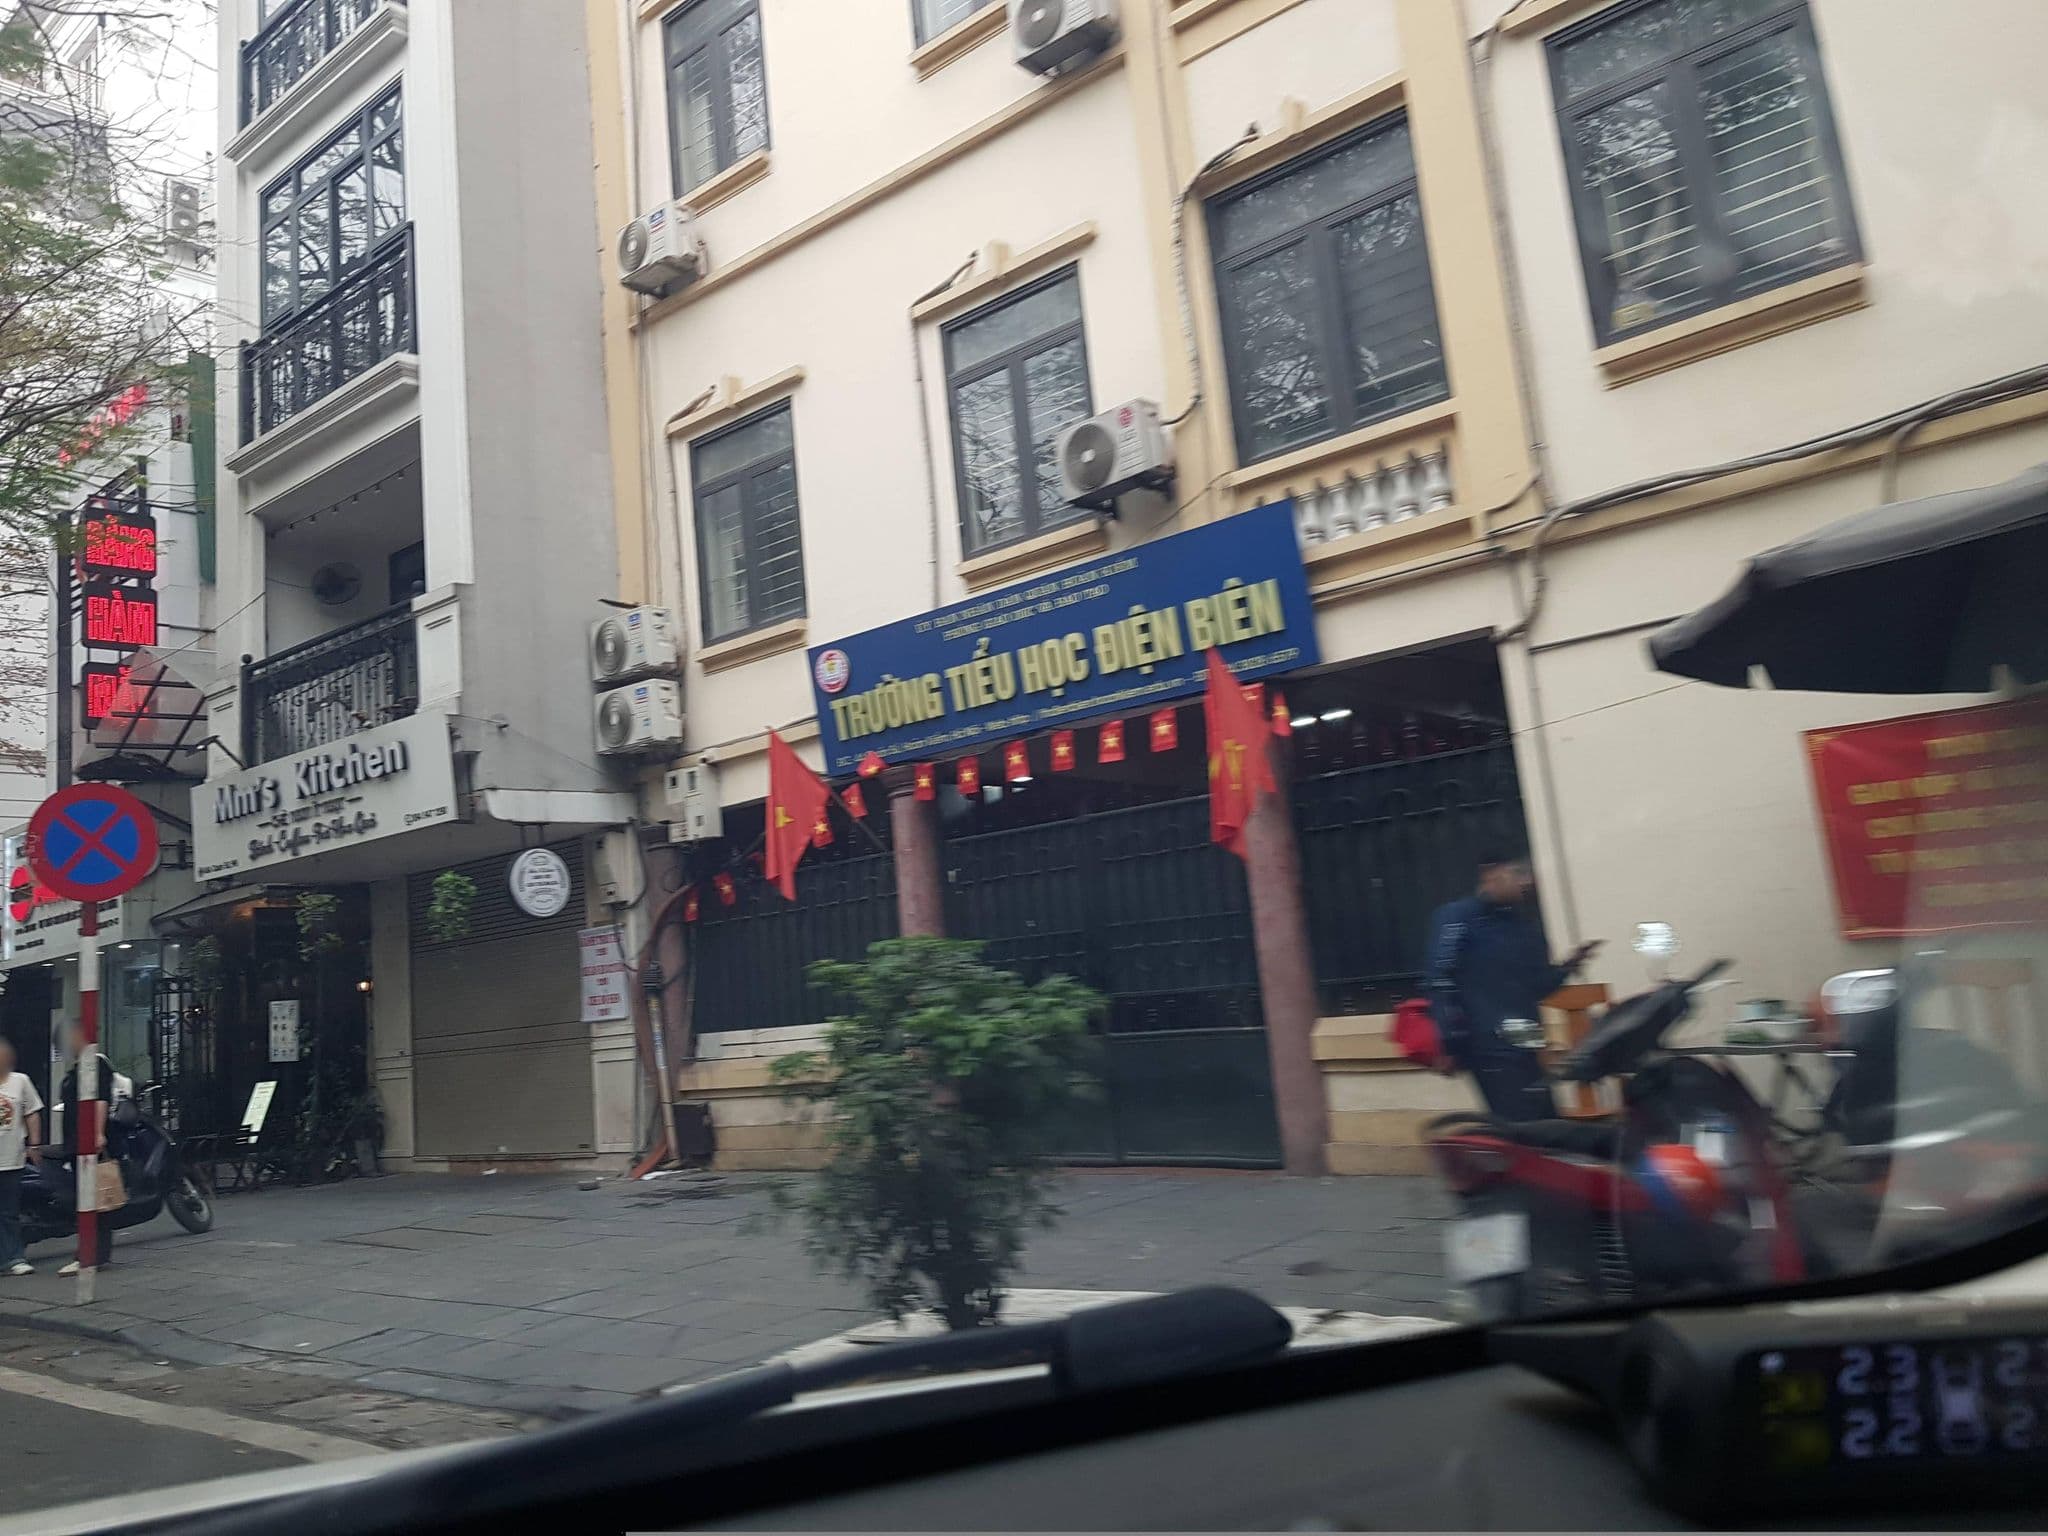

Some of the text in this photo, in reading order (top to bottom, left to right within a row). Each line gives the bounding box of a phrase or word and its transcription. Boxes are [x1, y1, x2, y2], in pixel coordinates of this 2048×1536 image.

[945, 637, 1016, 712] TIỂU
[1018, 631, 1089, 698] HỌC
[1092, 603, 1184, 675] ĐIỆN
[1184, 577, 1285, 652] BIÊN
[294, 741, 409, 800] Kitchen
